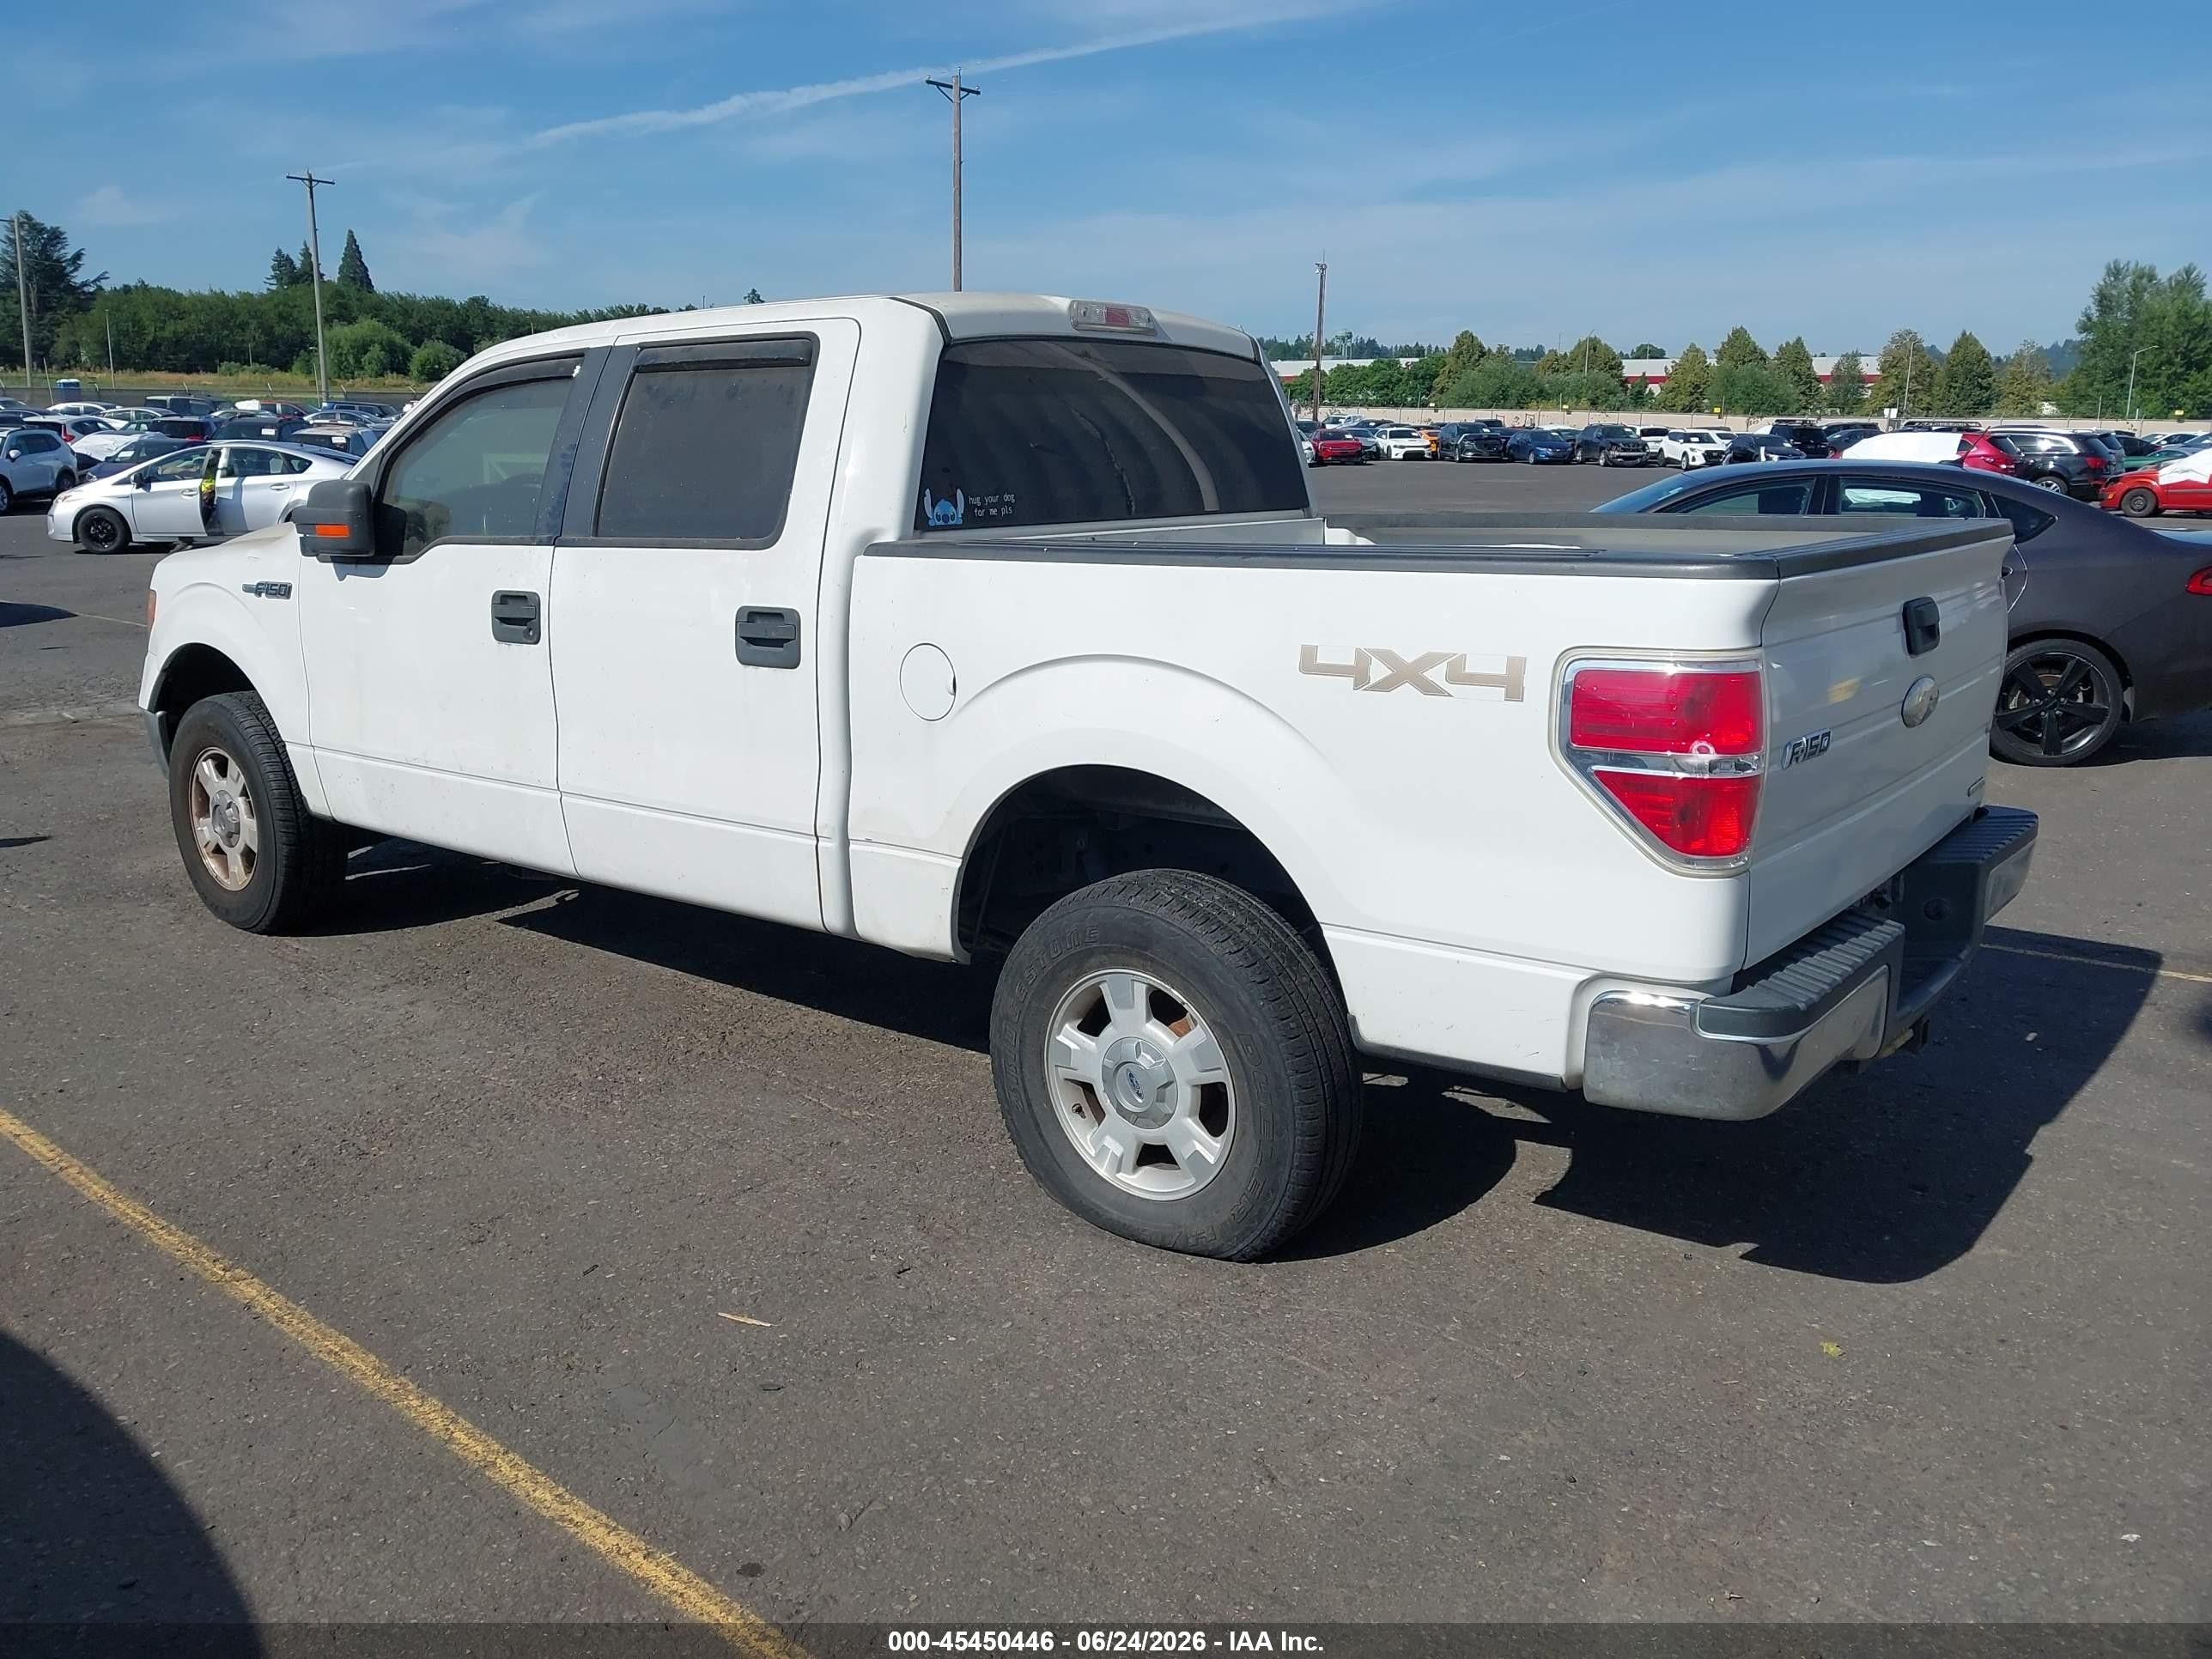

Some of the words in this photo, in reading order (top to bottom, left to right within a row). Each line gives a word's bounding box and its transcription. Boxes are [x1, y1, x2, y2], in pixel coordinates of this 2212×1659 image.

[968, 495, 981, 506] hug
[984, 494, 1000, 505] your
[1003, 492, 1016, 503] dog
[974, 507, 986, 517] for
[989, 507, 998, 516] me
[1001, 505, 1012, 517] pls
[1001, 925, 1100, 1113] BRIDGESTONE
[1230, 1033, 1276, 1224] DUELER
